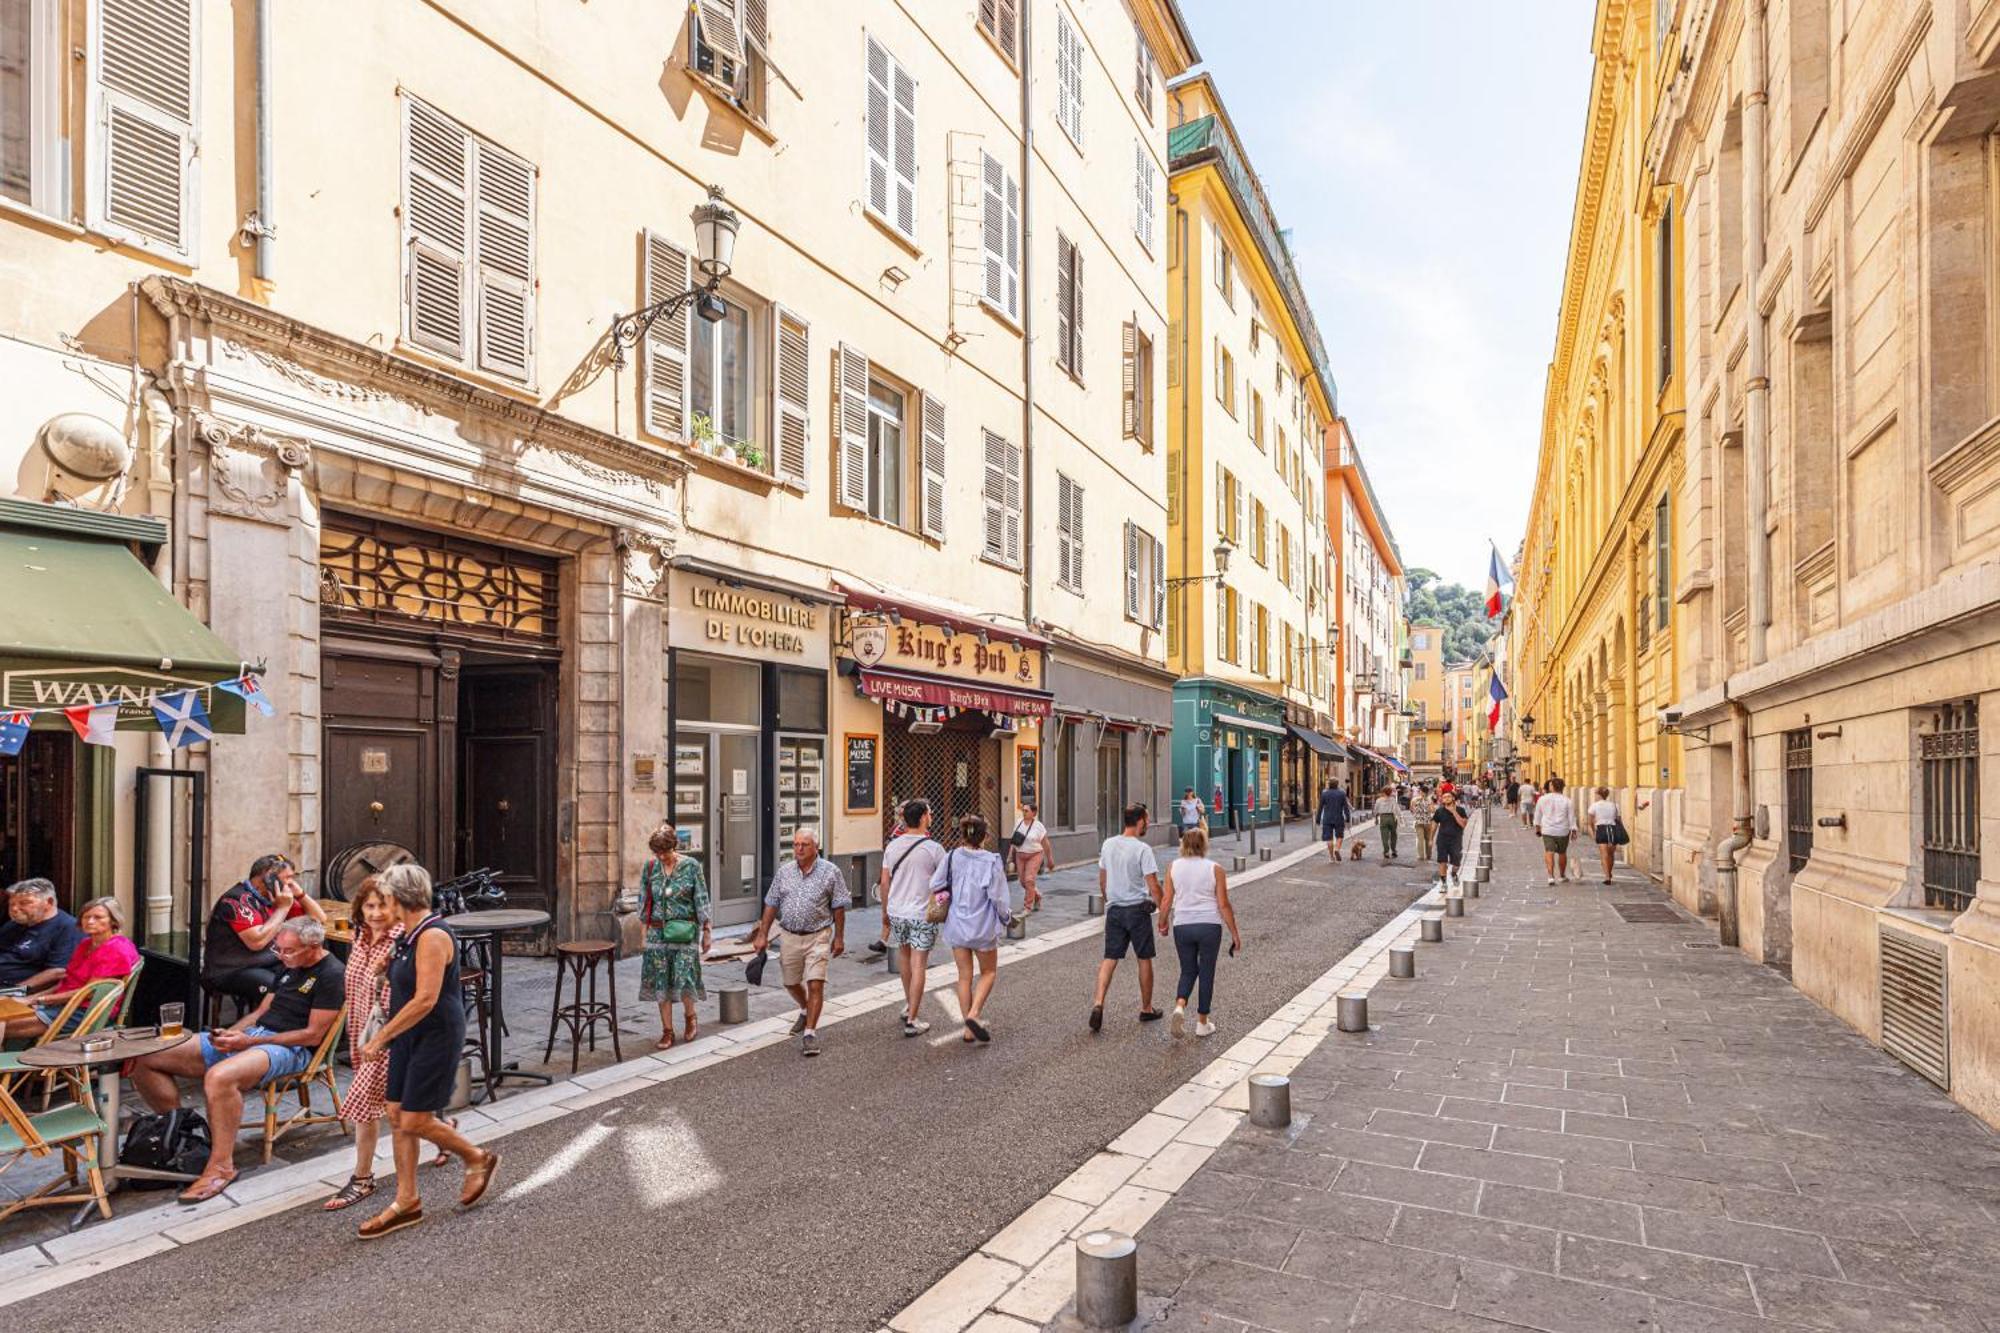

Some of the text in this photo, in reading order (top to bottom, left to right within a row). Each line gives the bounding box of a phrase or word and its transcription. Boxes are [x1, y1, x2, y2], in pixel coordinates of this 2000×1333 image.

[706, 619, 803, 653] DE L'OPERA
[897, 626, 1006, 675] King's Pub
[870, 680, 922, 698] LIVE MUSIC
[853, 739, 870, 749] LIVE
[850, 750, 872, 760] MUSIC
